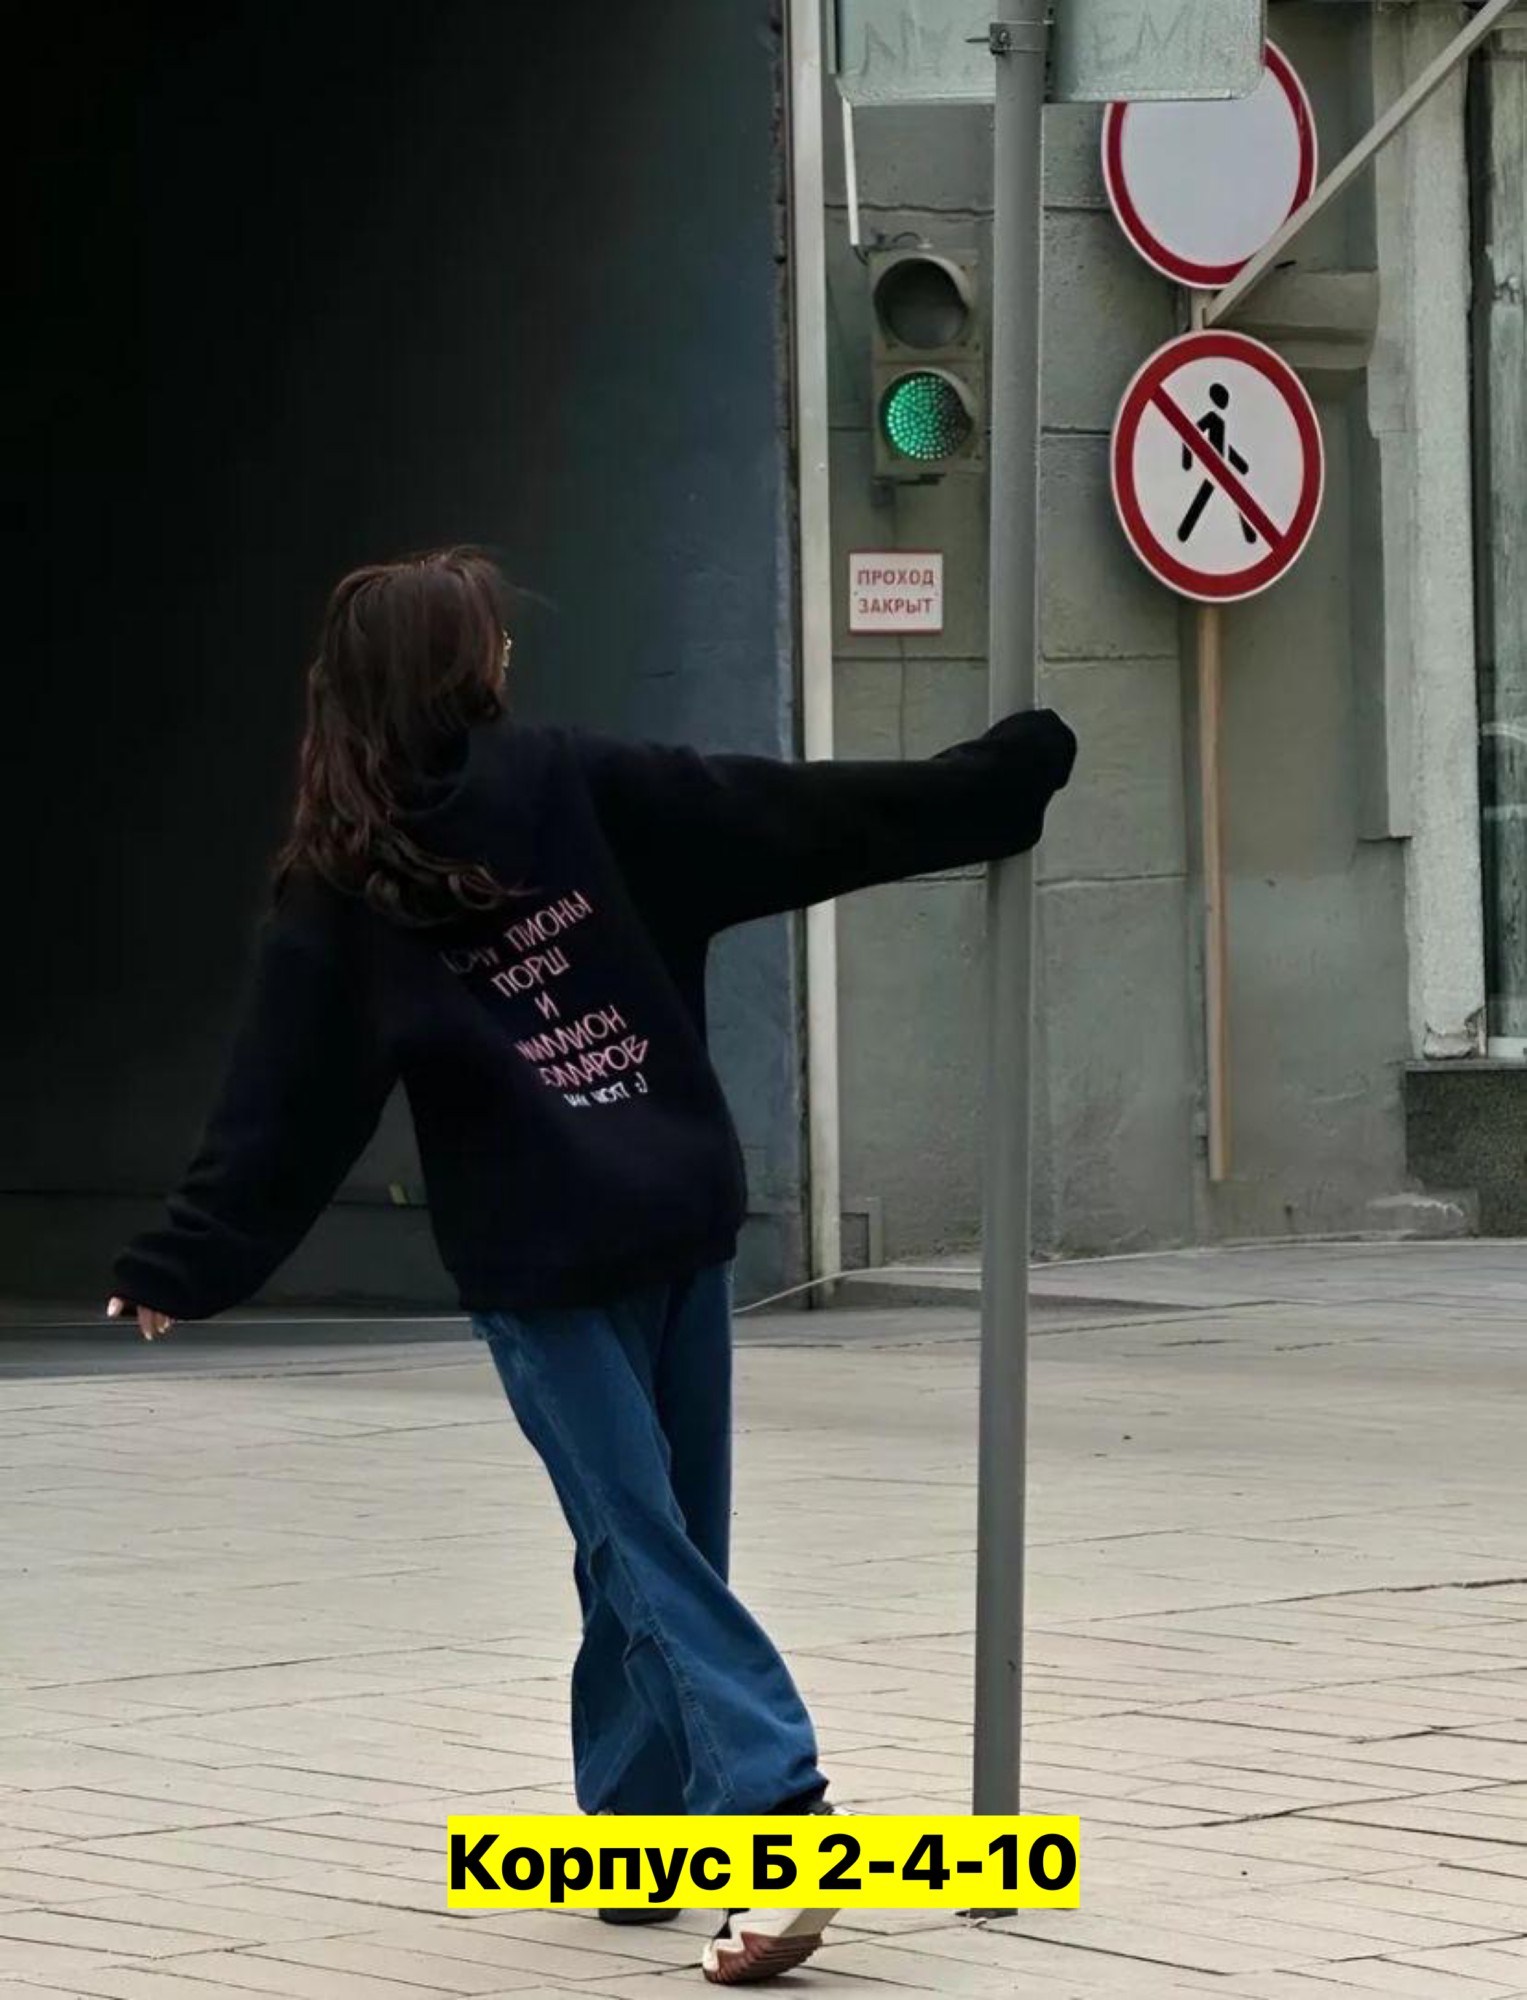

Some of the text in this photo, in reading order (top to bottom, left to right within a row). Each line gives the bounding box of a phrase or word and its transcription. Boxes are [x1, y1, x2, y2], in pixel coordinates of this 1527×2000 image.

[858, 569, 934, 587] ПРОХОД
[858, 597, 934, 614] ЗАКРЫТ
[504, 890, 593, 951] ПИОНЫ
[491, 946, 570, 997] ПОРШ
[534, 990, 560, 1019] И
